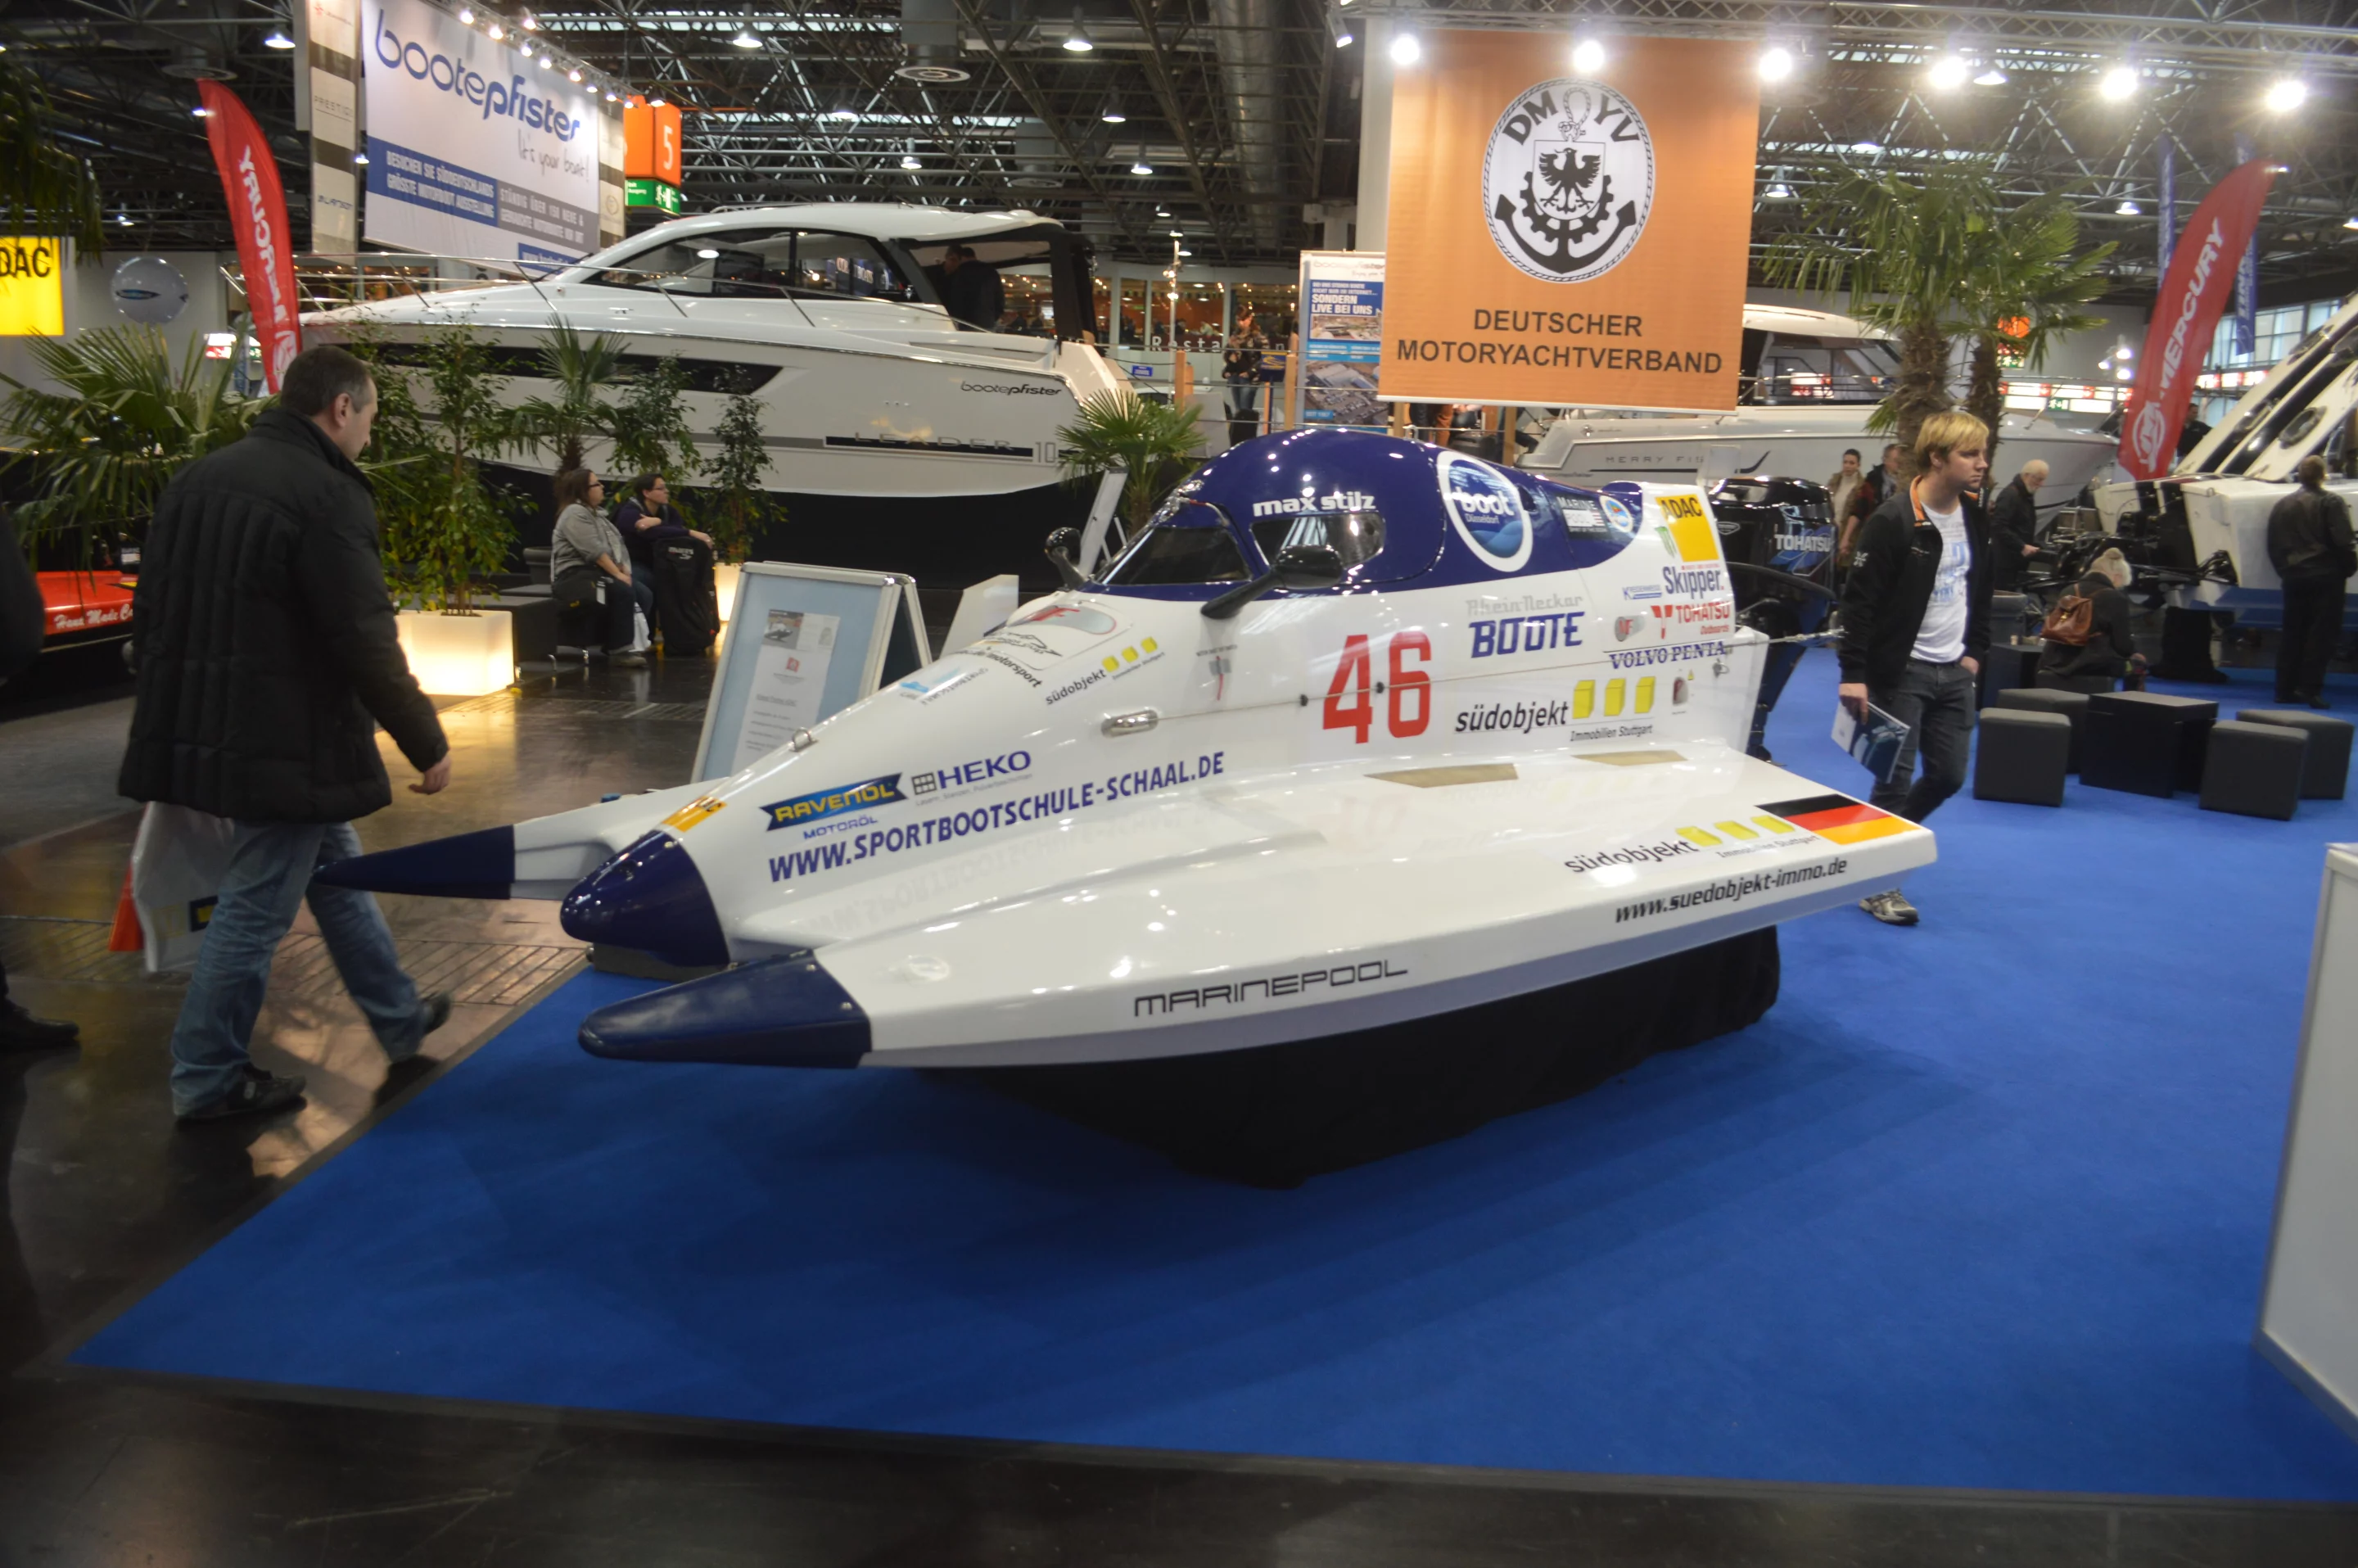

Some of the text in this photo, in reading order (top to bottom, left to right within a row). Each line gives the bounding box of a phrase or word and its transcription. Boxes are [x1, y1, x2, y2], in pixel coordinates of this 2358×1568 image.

[375, 8, 580, 142] bootepfister
[663, 124, 673, 170] 5
[423, 164, 436, 180] SIE
[539, 152, 560, 176] your
[387, 173, 417, 196] GRÖSSTE
[500, 188, 527, 210] STÄNDIG
[530, 193, 546, 215] ÜBER
[562, 208, 577, 225] NEUE
[1312, 294, 1357, 304] SONDERN
[1312, 304, 1373, 315] LIVE BEI UNS
[2158, 216, 2225, 399] MERCURY
[1474, 309, 1642, 337] DEUTSCHER
[1397, 340, 1723, 373] MOTORYACHTVERBAND
[960, 381, 1062, 395] bootepfister
[855, 432, 1057, 463] LEADER 10
[1606, 455, 1664, 464] MERRY
[1253, 491, 1376, 517] max stilz
[1457, 486, 1515, 517] boot
[1557, 496, 1598, 511] MARINE
[1660, 497, 1702, 519] ADAC
[1464, 513, 1500, 524] Düsseldorf
[1774, 534, 1832, 552] TOHATSU
[1466, 594, 1583, 616] Rhein-Neckar
[1675, 601, 1731, 624] TOHATSU
[1468, 612, 1585, 658] BOOTE
[1610, 640, 1727, 670] VOLVO PENTA
[986, 653, 1043, 689] motorsport
[1045, 667, 1107, 705] südobjekt
[1322, 630, 1432, 744] 46
[1454, 699, 1569, 734] südobjekt
[1570, 724, 1654, 742] Immobilien Stuttgart
[937, 750, 1032, 789] HEKO
[768, 751, 1225, 883] WWW.SPORTBOOTSCHULE-SCHAAL.DE
[774, 784, 896, 822] RAVENOL
[803, 814, 879, 841] MOTORÖL
[1564, 838, 1701, 874] südobjekt
[1716, 834, 1822, 859] Immobilien Stuttgart
[1615, 856, 1848, 924] www.suedobjekt-immo.de
[1134, 959, 1408, 1017] MARINEPOOL
